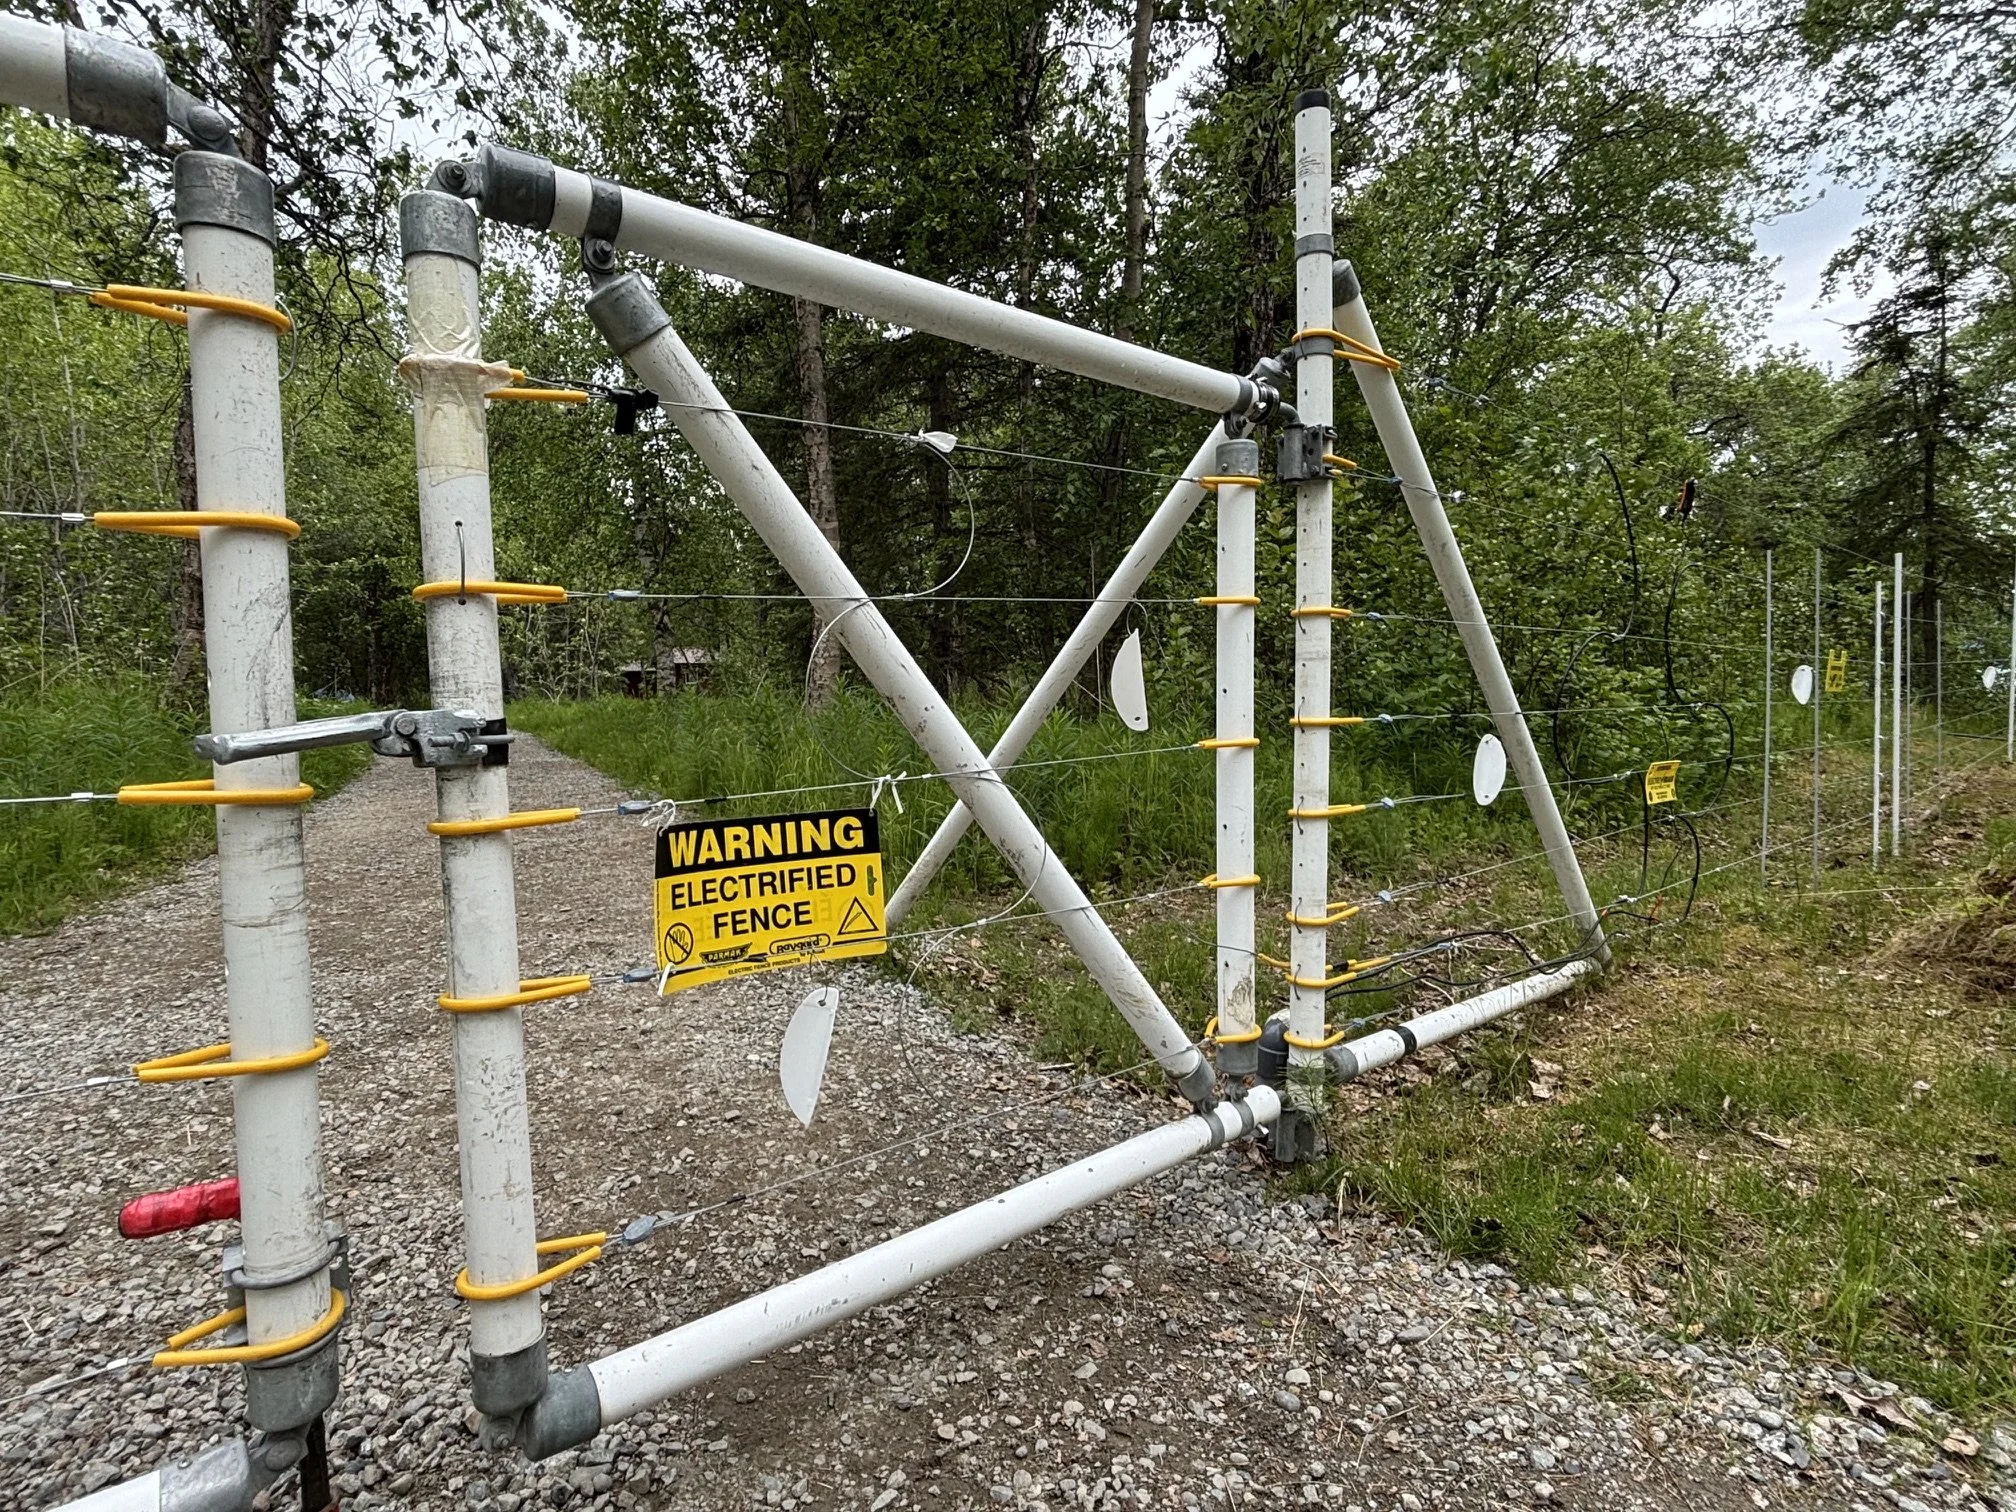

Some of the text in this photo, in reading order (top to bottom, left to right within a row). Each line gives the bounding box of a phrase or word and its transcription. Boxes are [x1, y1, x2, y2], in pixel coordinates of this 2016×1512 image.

[668, 816, 865, 868] WARNING
[671, 863, 857, 911] ELECTRIFIED
[713, 901, 813, 939] FENCE
[728, 957, 801, 975] ELECTRIC FENCE PRODUCTS
